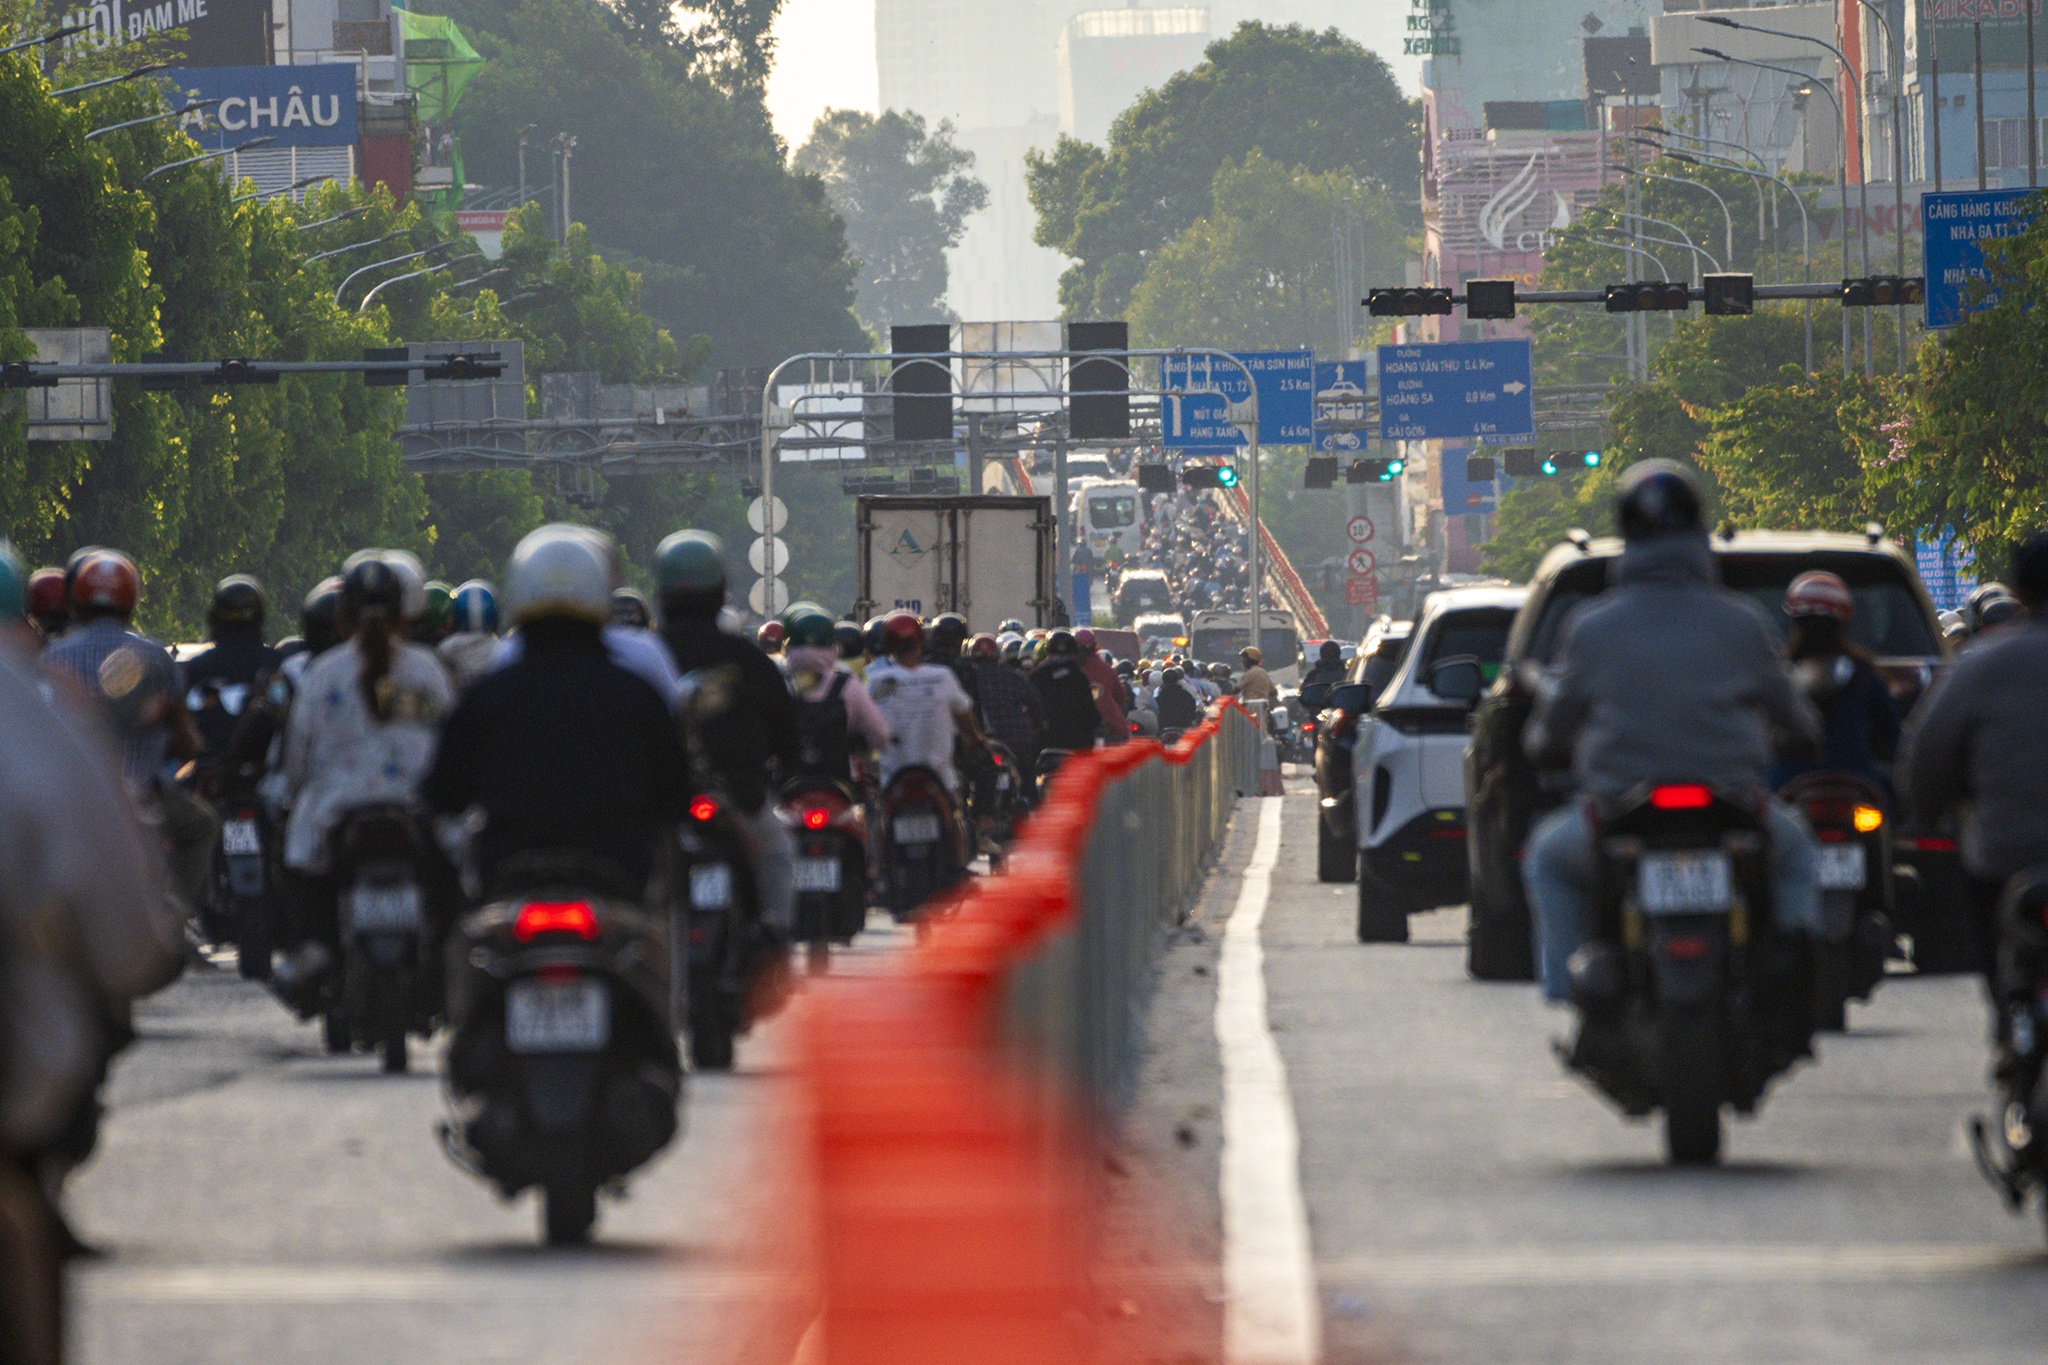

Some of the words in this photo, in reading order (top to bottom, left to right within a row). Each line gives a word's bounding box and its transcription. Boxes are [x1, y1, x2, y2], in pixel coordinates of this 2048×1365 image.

[218, 86, 340, 131] CHÂU
[1928, 199, 1958, 219] CẢNG
[1961, 198, 1991, 218] HÀNG
[1950, 220, 1976, 240] NHÀ
[1978, 223, 1993, 239] GA
[1943, 263, 1968, 284] NHÀ
